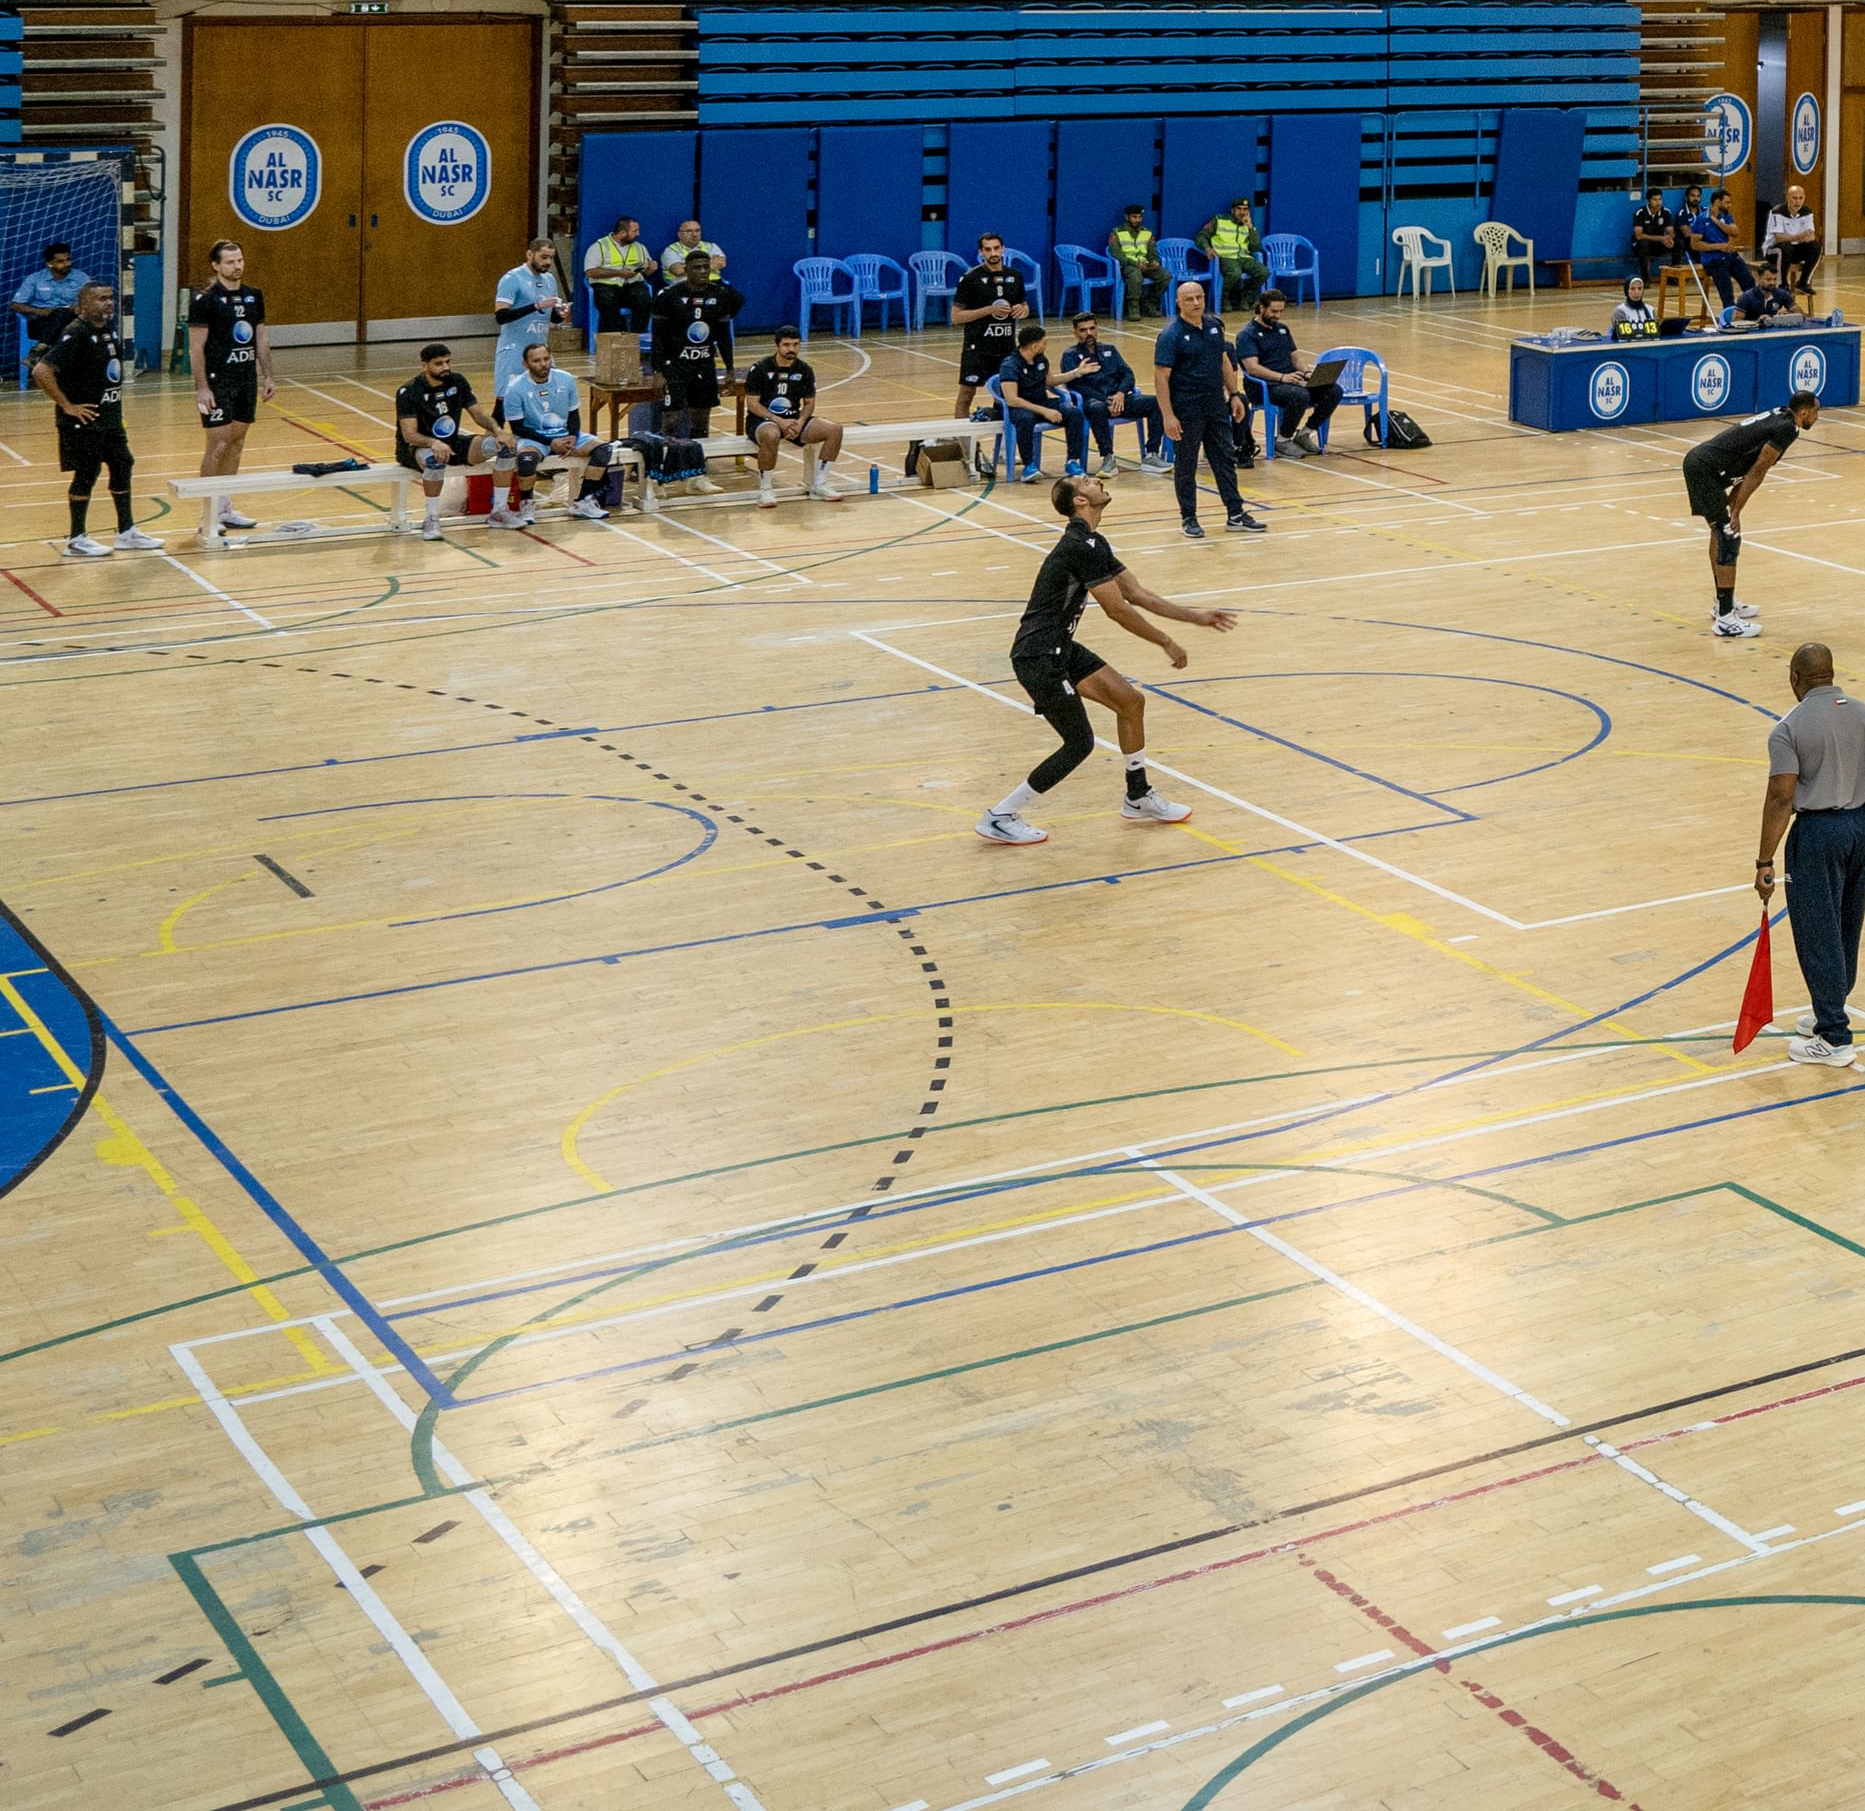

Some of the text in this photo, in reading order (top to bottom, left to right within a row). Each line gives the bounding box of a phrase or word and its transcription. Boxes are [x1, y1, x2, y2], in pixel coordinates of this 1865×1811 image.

[266, 130, 289, 138] 1945
[1798, 127, 1815, 142] NASR
[266, 152, 286, 168] AL
[438, 148, 458, 163] AL
[248, 169, 303, 189] NASR
[421, 164, 473, 184] NASR
[267, 190, 283, 202] SC
[440, 185, 455, 197] SC
[258, 215, 291, 225] DUBAI
[432, 209, 464, 219] DUBAI
[234, 305, 245, 317] 22
[1619, 322, 1632, 335] 16
[1644, 321, 1657, 334] 13
[1803, 360, 1812, 369] AL
[1707, 369, 1716, 377] AL
[1796, 367, 1818, 380] NASR
[1605, 377, 1613, 385] AL
[1699, 377, 1722, 389] NASR
[777, 383, 788, 395] 10
[1597, 385, 1621, 397] NASR
